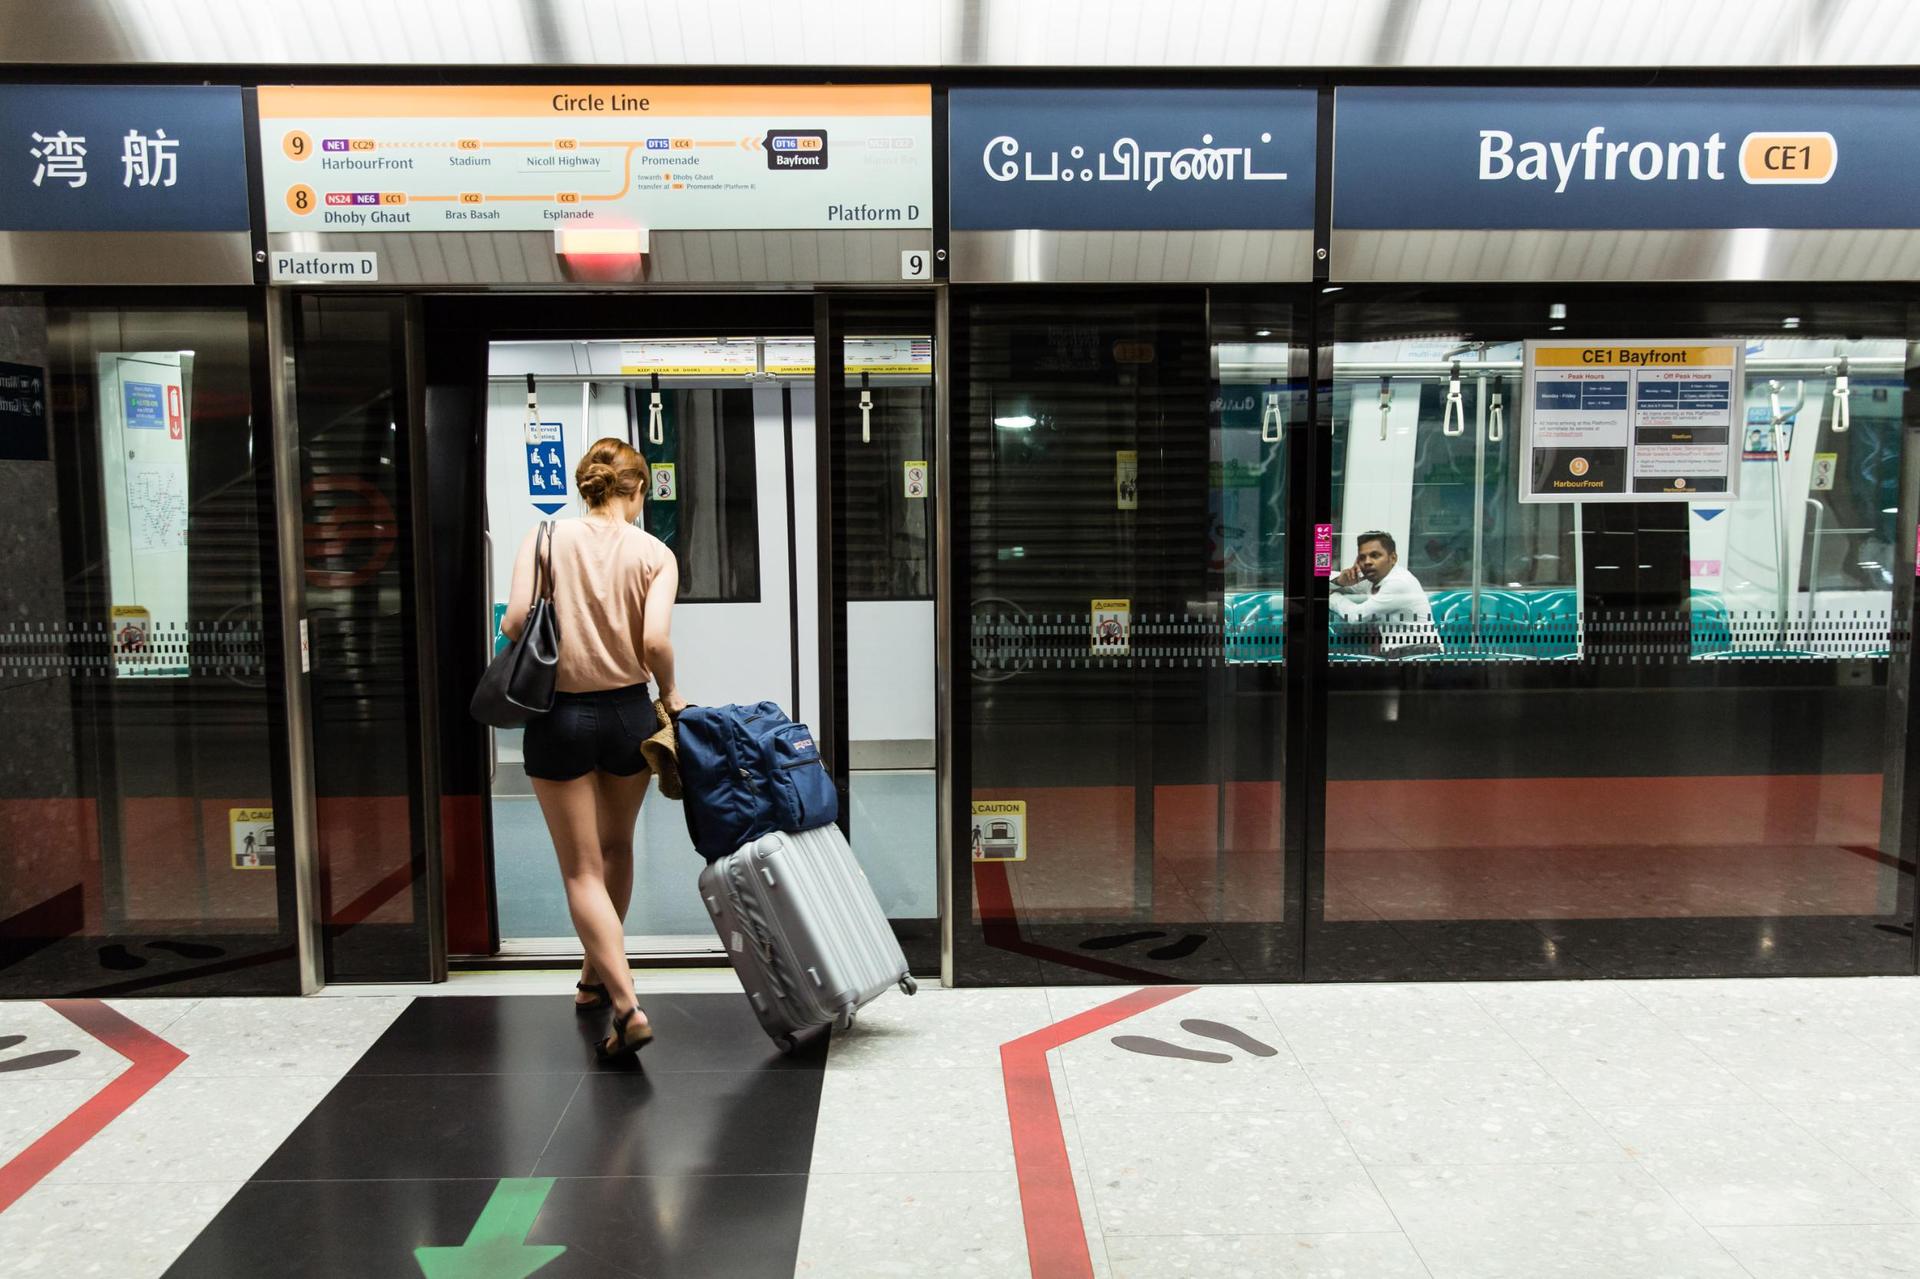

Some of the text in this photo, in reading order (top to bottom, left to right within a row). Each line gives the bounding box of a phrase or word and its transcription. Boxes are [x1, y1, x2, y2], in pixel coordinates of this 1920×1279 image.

[552, 94, 650, 111] Circle Line
[292, 137, 304, 155] 9
[327, 140, 374, 151] NE1 CC29
[462, 140, 477, 149] CC6
[559, 140, 574, 149] CC5
[649, 139, 689, 149] DT15 CC4
[776, 139, 816, 149] DT16 CE1
[29, 128, 180, 188] 湾舫
[321, 157, 414, 170] HarbourFront
[449, 156, 491, 167] Stadium
[526, 156, 601, 169] Nicoll Highway
[641, 156, 700, 166] Promenade
[776, 154, 820, 167] Bayfront
[982, 132, 1288, 191] பேஃபிரண்ட்
[1479, 126, 1812, 193] Bayfront CE1
[296, 191, 308, 209] 8
[328, 193, 401, 204] NS24 NE6 CC1
[464, 193, 479, 203] CC2
[560, 193, 575, 203] CC3
[324, 211, 411, 225] Dhoby Ghaut
[445, 209, 500, 220] Bras Basah
[543, 209, 594, 221] Esplanade
[828, 205, 919, 222] Platform D
[278, 259, 373, 275] Platform D
[910, 255, 923, 275] 9
[1582, 349, 1687, 365] CE1 Bayfront
[1575, 461, 1583, 471] 9
[1553, 480, 1604, 488] HarbourFront
[978, 804, 1020, 812] CAUTION
